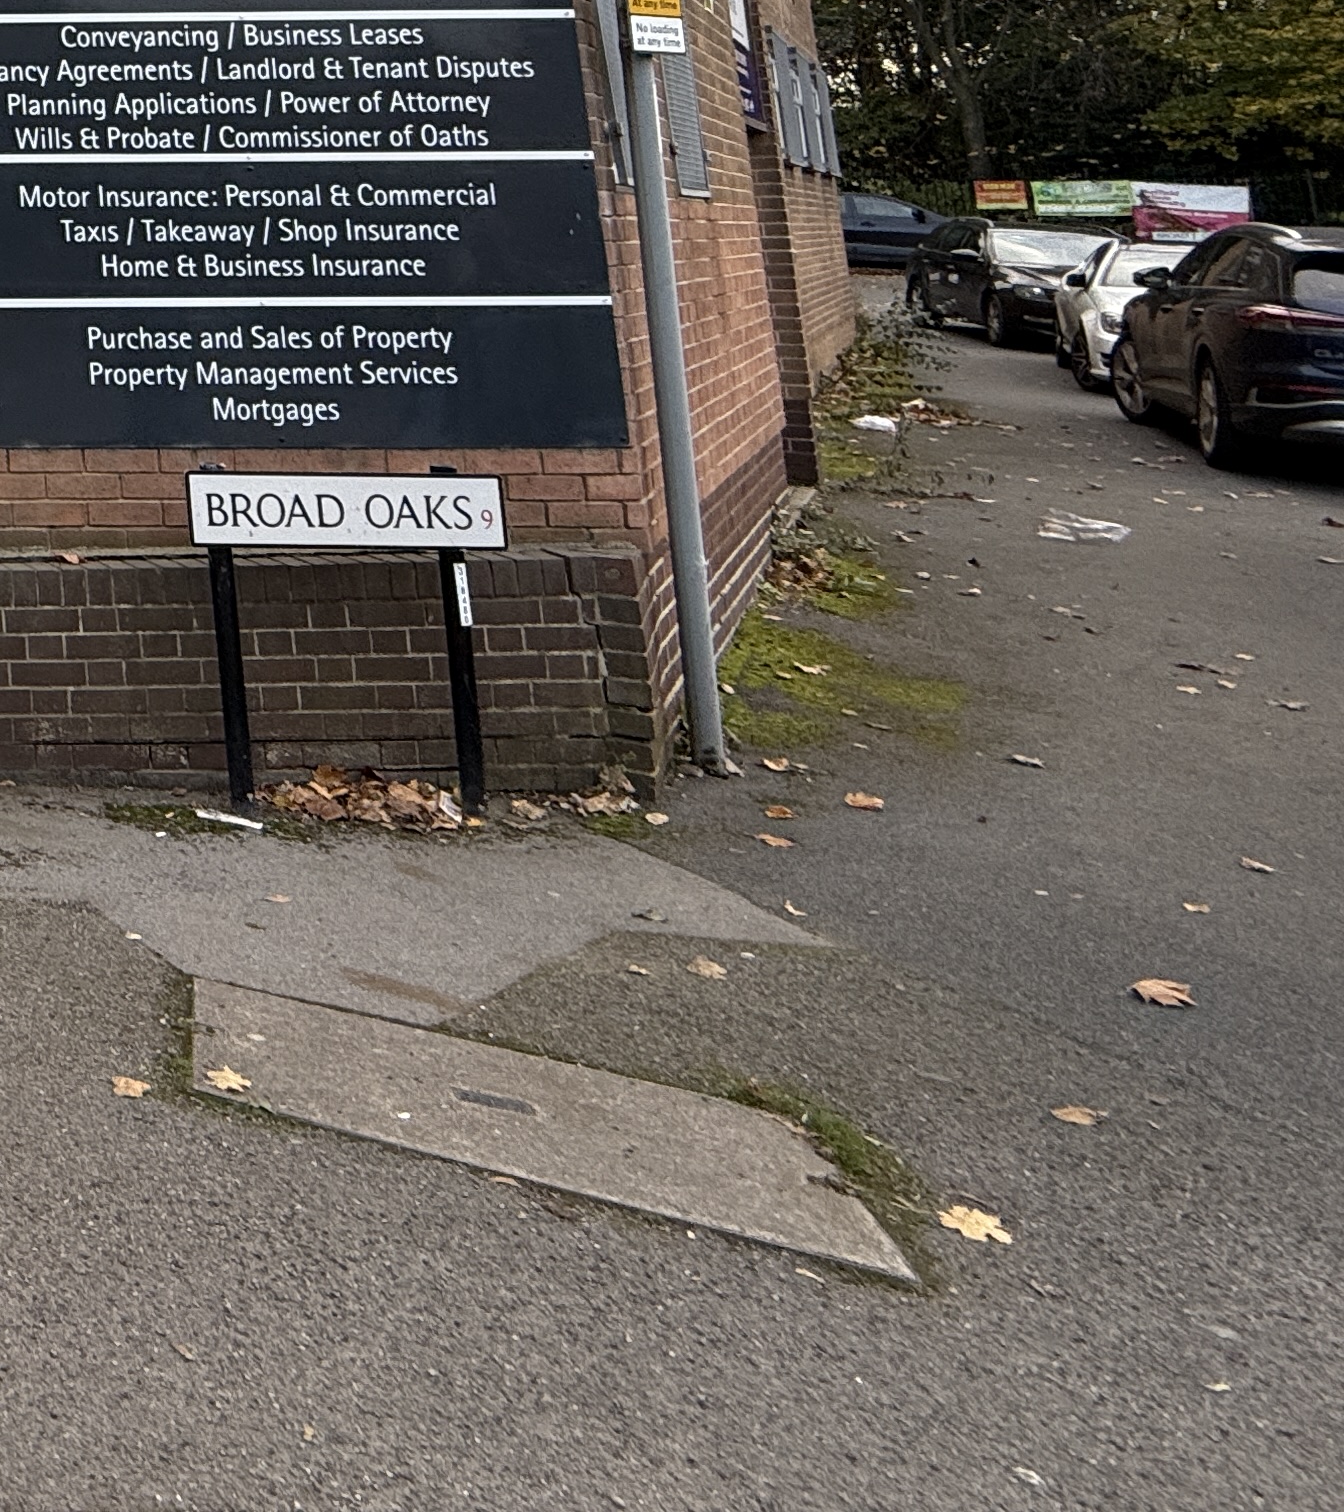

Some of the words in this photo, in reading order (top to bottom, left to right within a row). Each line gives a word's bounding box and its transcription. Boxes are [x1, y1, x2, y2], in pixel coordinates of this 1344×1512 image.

[644, 0, 658, 10] any
[659, 0, 677, 10] time
[61, 25, 218, 52] Conveyancing
[228, 22, 234, 49] /
[244, 24, 342, 45] Business
[350, 23, 423, 45] Leases
[636, 23, 649, 33] No
[650, 23, 679, 37] loading
[637, 36, 645, 45] at
[647, 38, 661, 47] any
[663, 37, 681, 48] time
[57, 60, 193, 87] Agreements
[201, 56, 208, 84] /
[217, 57, 315, 80] Landlord
[324, 58, 344, 79] &
[349, 57, 429, 78] Tenant
[437, 56, 534, 83] Disputes
[8, 93, 106, 120] Planning
[115, 92, 256, 120] Applications
[265, 90, 271, 117] /
[281, 91, 350, 113] Power
[359, 91, 382, 112] of
[390, 90, 490, 117] Attorney
[15, 127, 72, 149] Wills
[80, 128, 100, 149] &
[108, 127, 194, 148] Probate
[203, 124, 210, 152] /
[219, 125, 381, 148] Commissioner
[390, 124, 413, 147] of
[421, 124, 488, 146] Oaths
[20, 186, 90, 207] Motor
[99, 185, 217, 207] Insurance:
[226, 184, 321, 206] Personal
[330, 185, 351, 206] &
[358, 183, 496, 206] Commercial
[60, 220, 118, 242] Taxis
[127, 218, 134, 245] /
[141, 219, 254, 247] Takeaway
[264, 217, 270, 245] /
[279, 218, 337, 247] Shop
[346, 218, 459, 241] Insurance
[102, 254, 168, 277] Home
[177, 255, 197, 277] &
[205, 254, 304, 277] Business
[312, 254, 425, 276] Insurance
[88, 326, 192, 349] Purchase
[201, 326, 243, 349] and
[251, 326, 312, 348] Sales
[321, 325, 344, 348] of
[353, 326, 452, 354] Property
[90, 362, 188, 391] Property
[196, 362, 353, 390] Management
[360, 361, 458, 384] Services
[213, 397, 339, 426] Mortgages
[205, 493, 345, 529] BROAD
[364, 494, 473, 530] OAKS
[480, 509, 493, 530] 9
